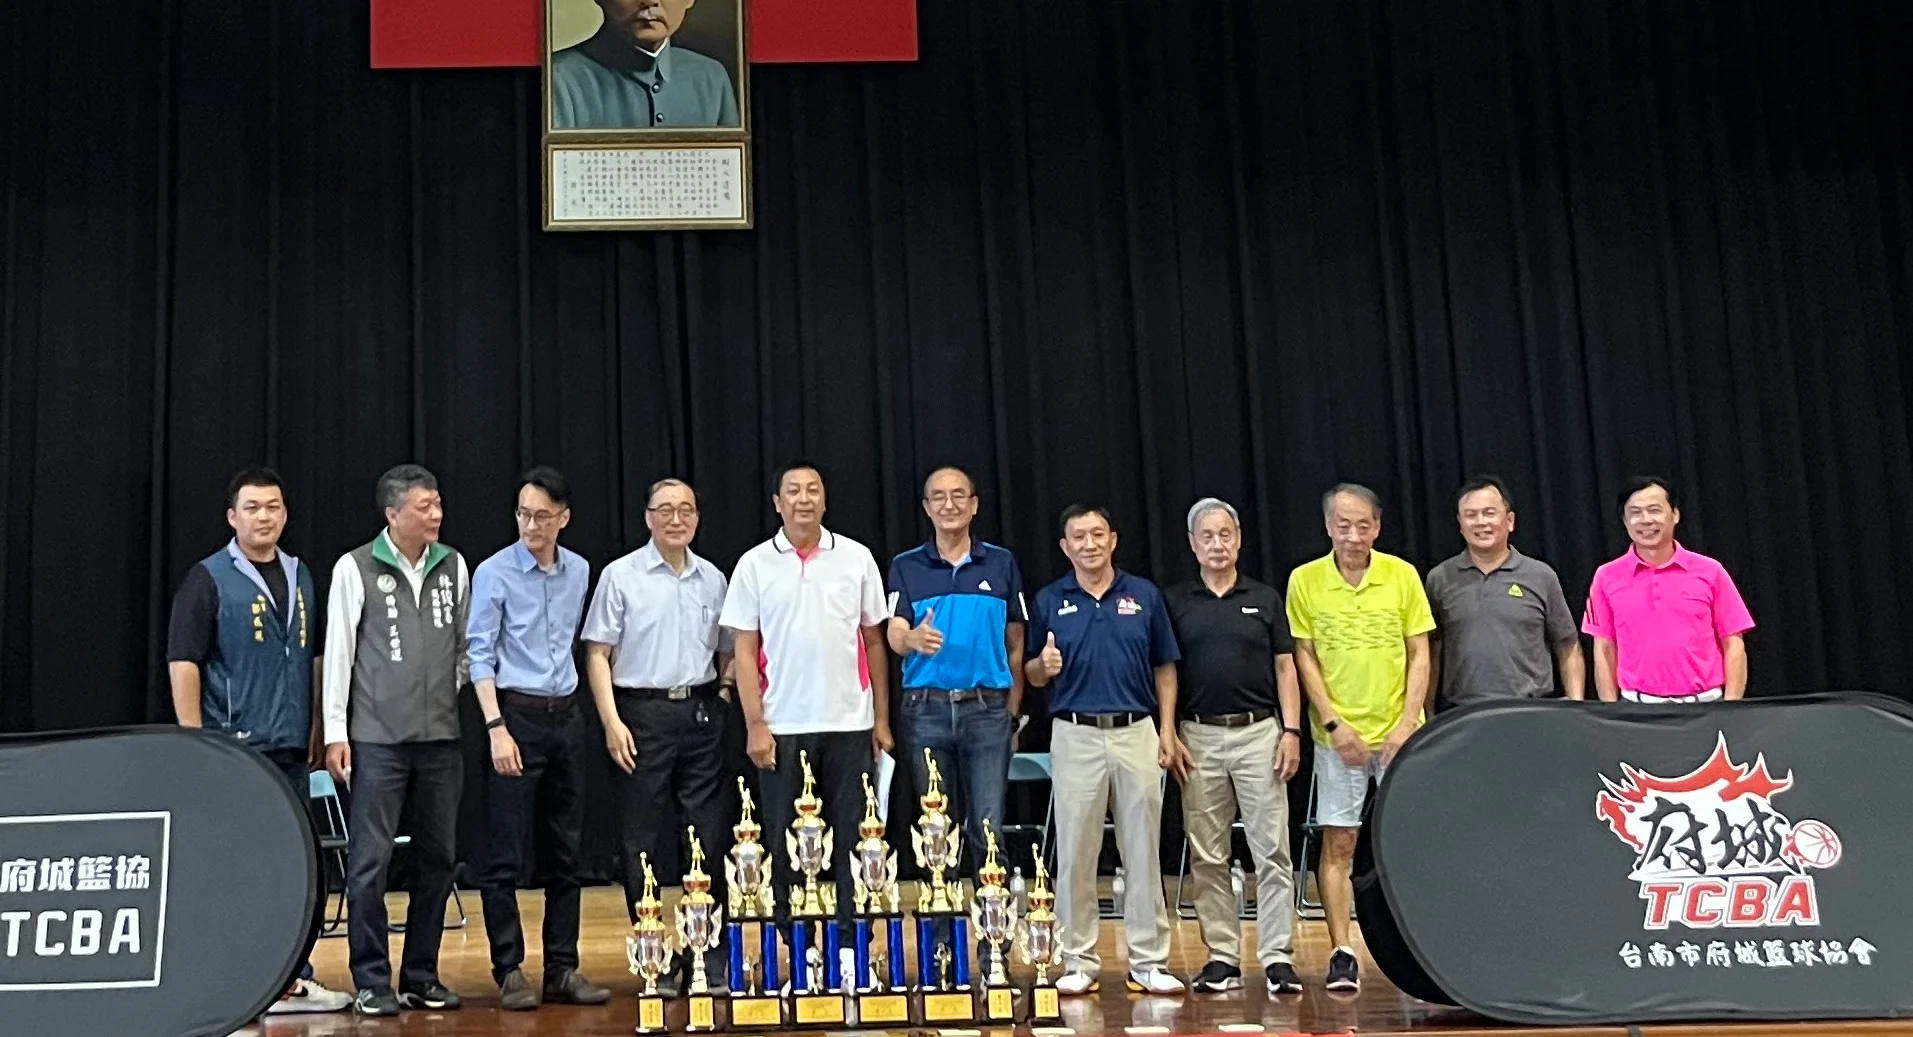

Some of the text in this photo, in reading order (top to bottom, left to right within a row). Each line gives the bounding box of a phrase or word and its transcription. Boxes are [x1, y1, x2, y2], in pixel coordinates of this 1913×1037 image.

[1632, 796, 1804, 876] 府城
[0, 855, 150, 893] 府城籃協
[1643, 878, 1816, 928] TCBA
[1, 908, 141, 957] TCBA
